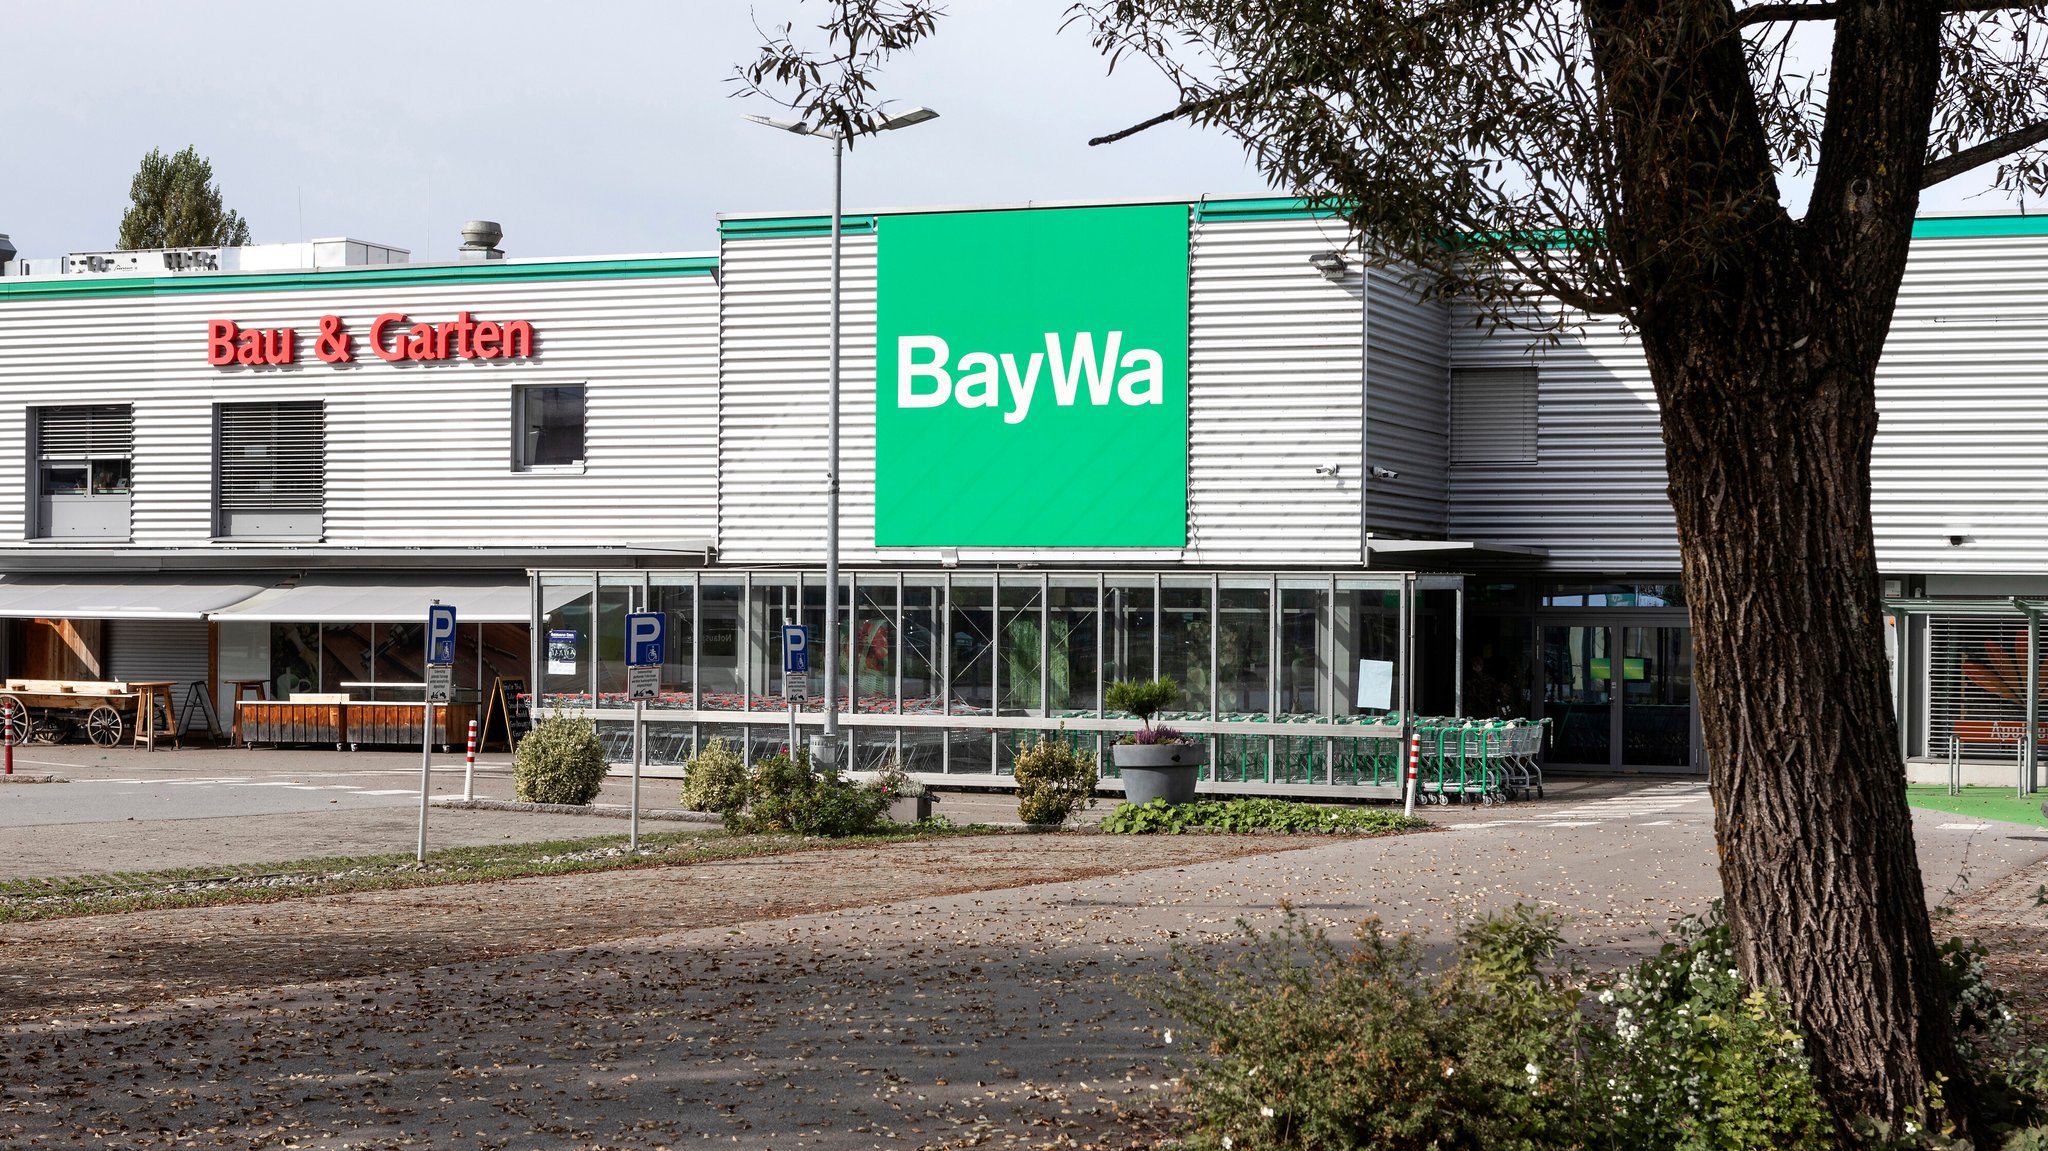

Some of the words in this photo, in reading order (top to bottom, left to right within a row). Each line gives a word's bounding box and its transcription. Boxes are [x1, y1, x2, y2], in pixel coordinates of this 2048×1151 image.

[208, 319, 295, 366] Bau
[314, 315, 353, 363] &
[369, 311, 534, 362] Garten
[897, 331, 1164, 424] BayWa
[431, 610, 453, 660] P
[631, 617, 661, 663] P
[786, 628, 805, 669] P
